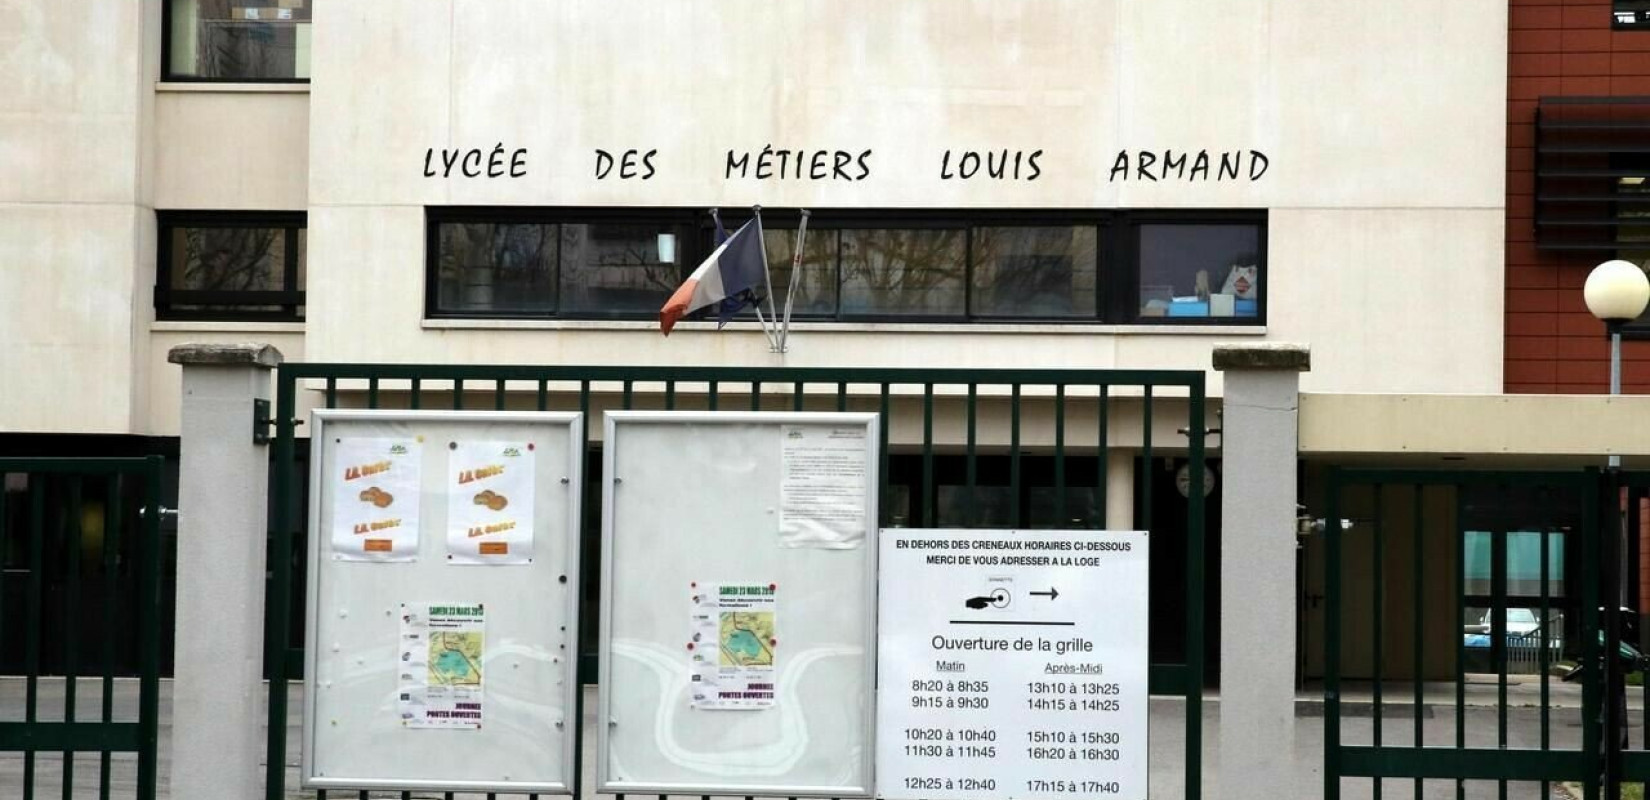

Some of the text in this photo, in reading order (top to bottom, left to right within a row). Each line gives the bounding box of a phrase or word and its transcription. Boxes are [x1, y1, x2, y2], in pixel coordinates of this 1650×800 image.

[423, 142, 1269, 182] LYCÉE DES MÉTIERS LOUIS ARMAND
[896, 539, 1131, 552] EN DEHORS DES CRENEAUX HORAIRES CI-DESSOUS
[926, 555, 1100, 567] MERCI DE VOUS ADRESSER A LA LOGE
[931, 635, 1093, 656] Ouverture de la grille
[936, 660, 965, 672] Matin
[1044, 662, 1103, 676] Après-Midi
[911, 680, 988, 692] 8h20 à 8h35
[1027, 682, 1120, 694] 13h10 à 13h25
[911, 696, 988, 708] 9h15 à 9h30
[1027, 698, 1120, 711] 14h15 à 14h25
[905, 728, 996, 741] 10h20 à 10h40
[1027, 731, 1120, 744] 15h10 à 15h30
[905, 745, 996, 758] 11h30 à 11h45
[1027, 747, 1120, 760] 16h20 à 16h30
[905, 777, 996, 791] 12h25 à 12h40
[1027, 780, 1120, 793] 17h15 à 17h40
